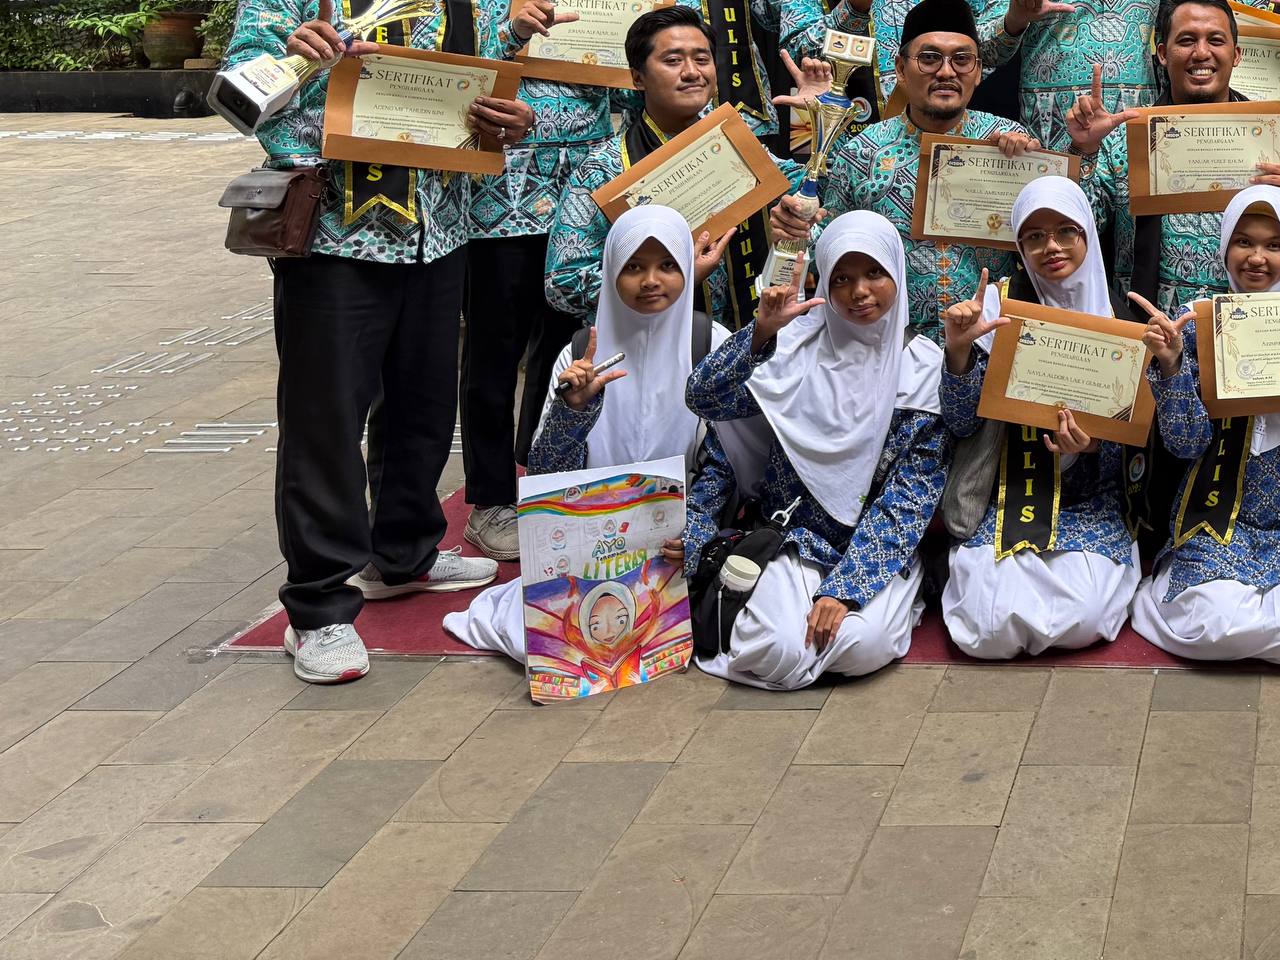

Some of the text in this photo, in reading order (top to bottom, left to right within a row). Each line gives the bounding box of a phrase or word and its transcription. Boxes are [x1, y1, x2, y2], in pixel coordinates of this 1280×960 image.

[375, 69, 453, 88] SERTIFIKAT
[1184, 126, 1248, 138] SERTIFIKAT
[651, 150, 710, 197] SERTIFIKAT
[968, 157, 1034, 172] SERTIFIKAT
[1038, 336, 1108, 358] SERTIFIKAT
[592, 536, 626, 558] AYO
